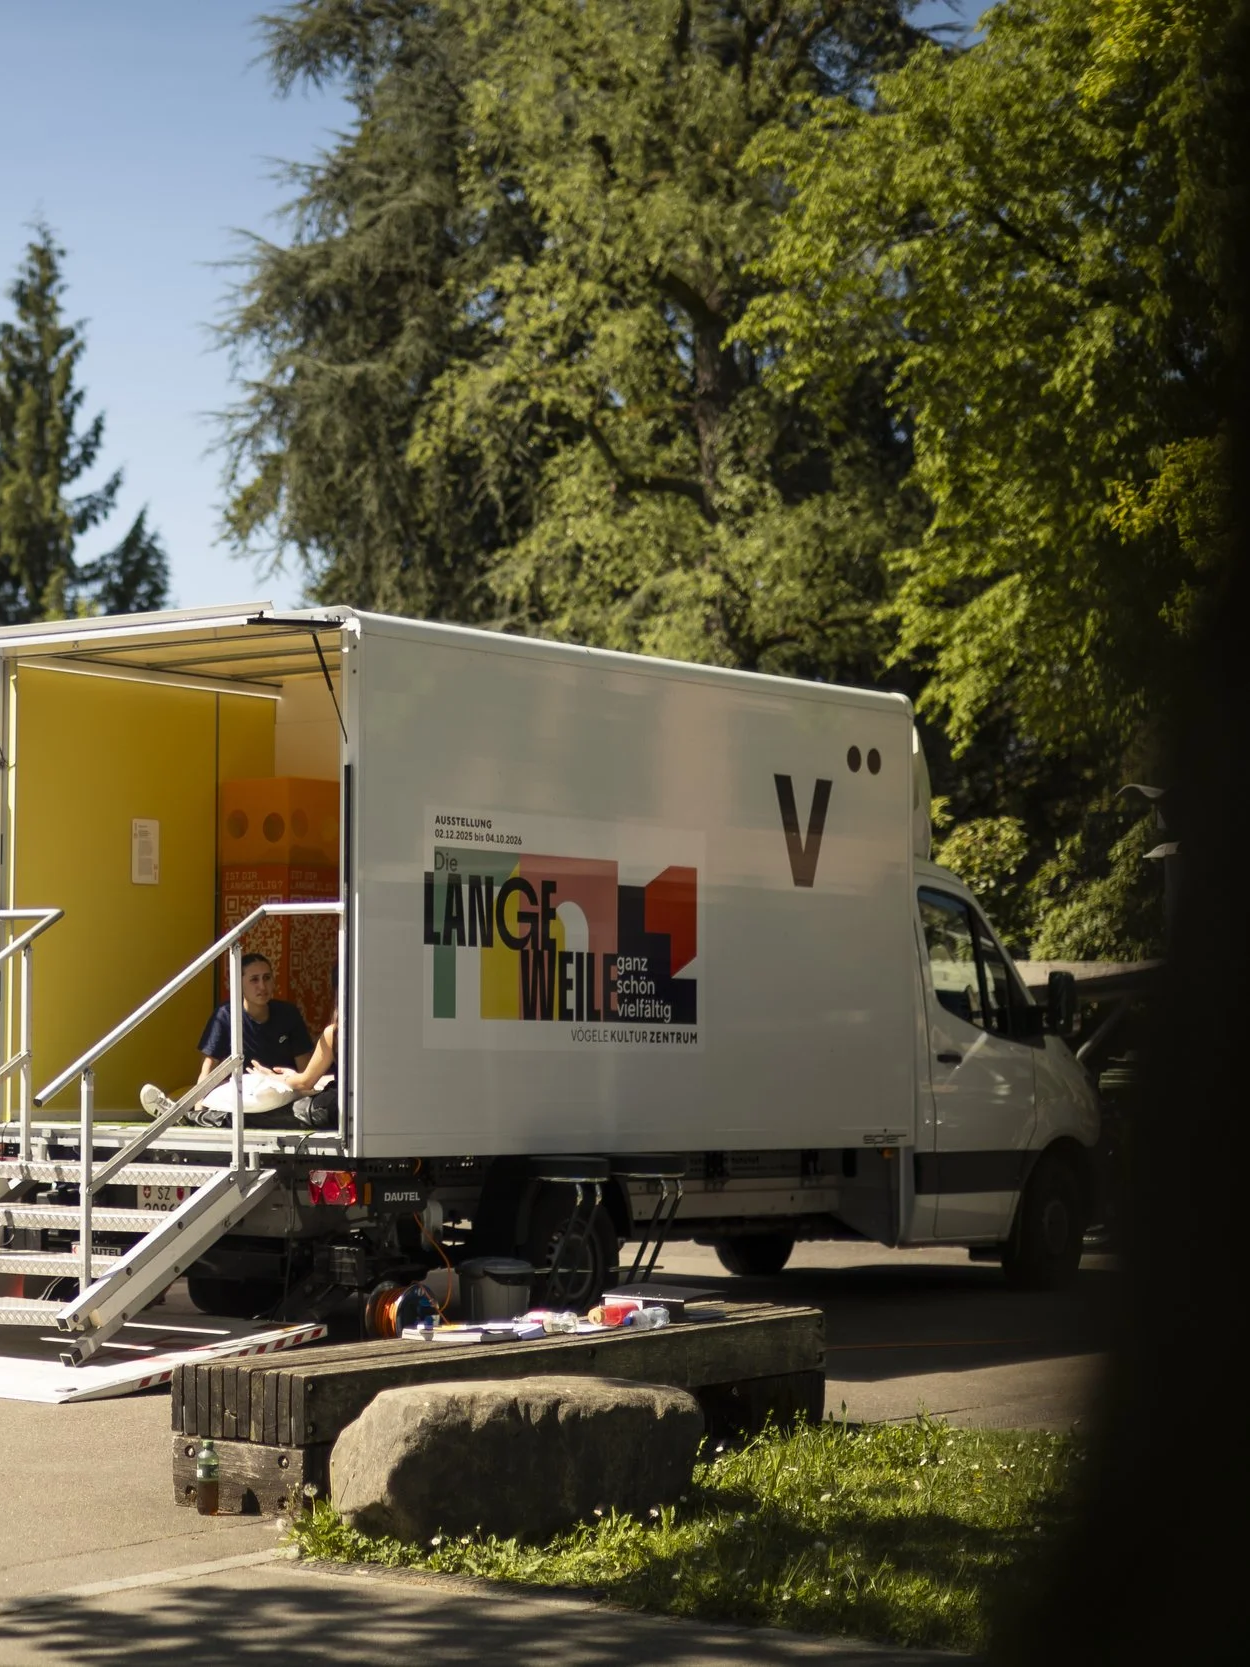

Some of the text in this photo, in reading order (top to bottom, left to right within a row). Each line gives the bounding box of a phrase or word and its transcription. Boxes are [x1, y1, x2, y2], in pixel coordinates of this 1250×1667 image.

[435, 815, 492, 829] AUSSTELLUNG
[434, 829, 523, 846] 02.12.2025 bis 04.10.2026
[434, 851, 458, 872] Die
[424, 871, 557, 951] LANGE
[616, 954, 648, 975] ganz
[520, 948, 618, 1022] WEILE
[616, 976, 656, 995] schön
[617, 999, 672, 1023] vielfältig
[571, 1027, 698, 1045] VÖGELE KULTUR ZENTRUM
[158, 1187, 171, 1200] SZ
[384, 1191, 421, 1202] DAUTEL
